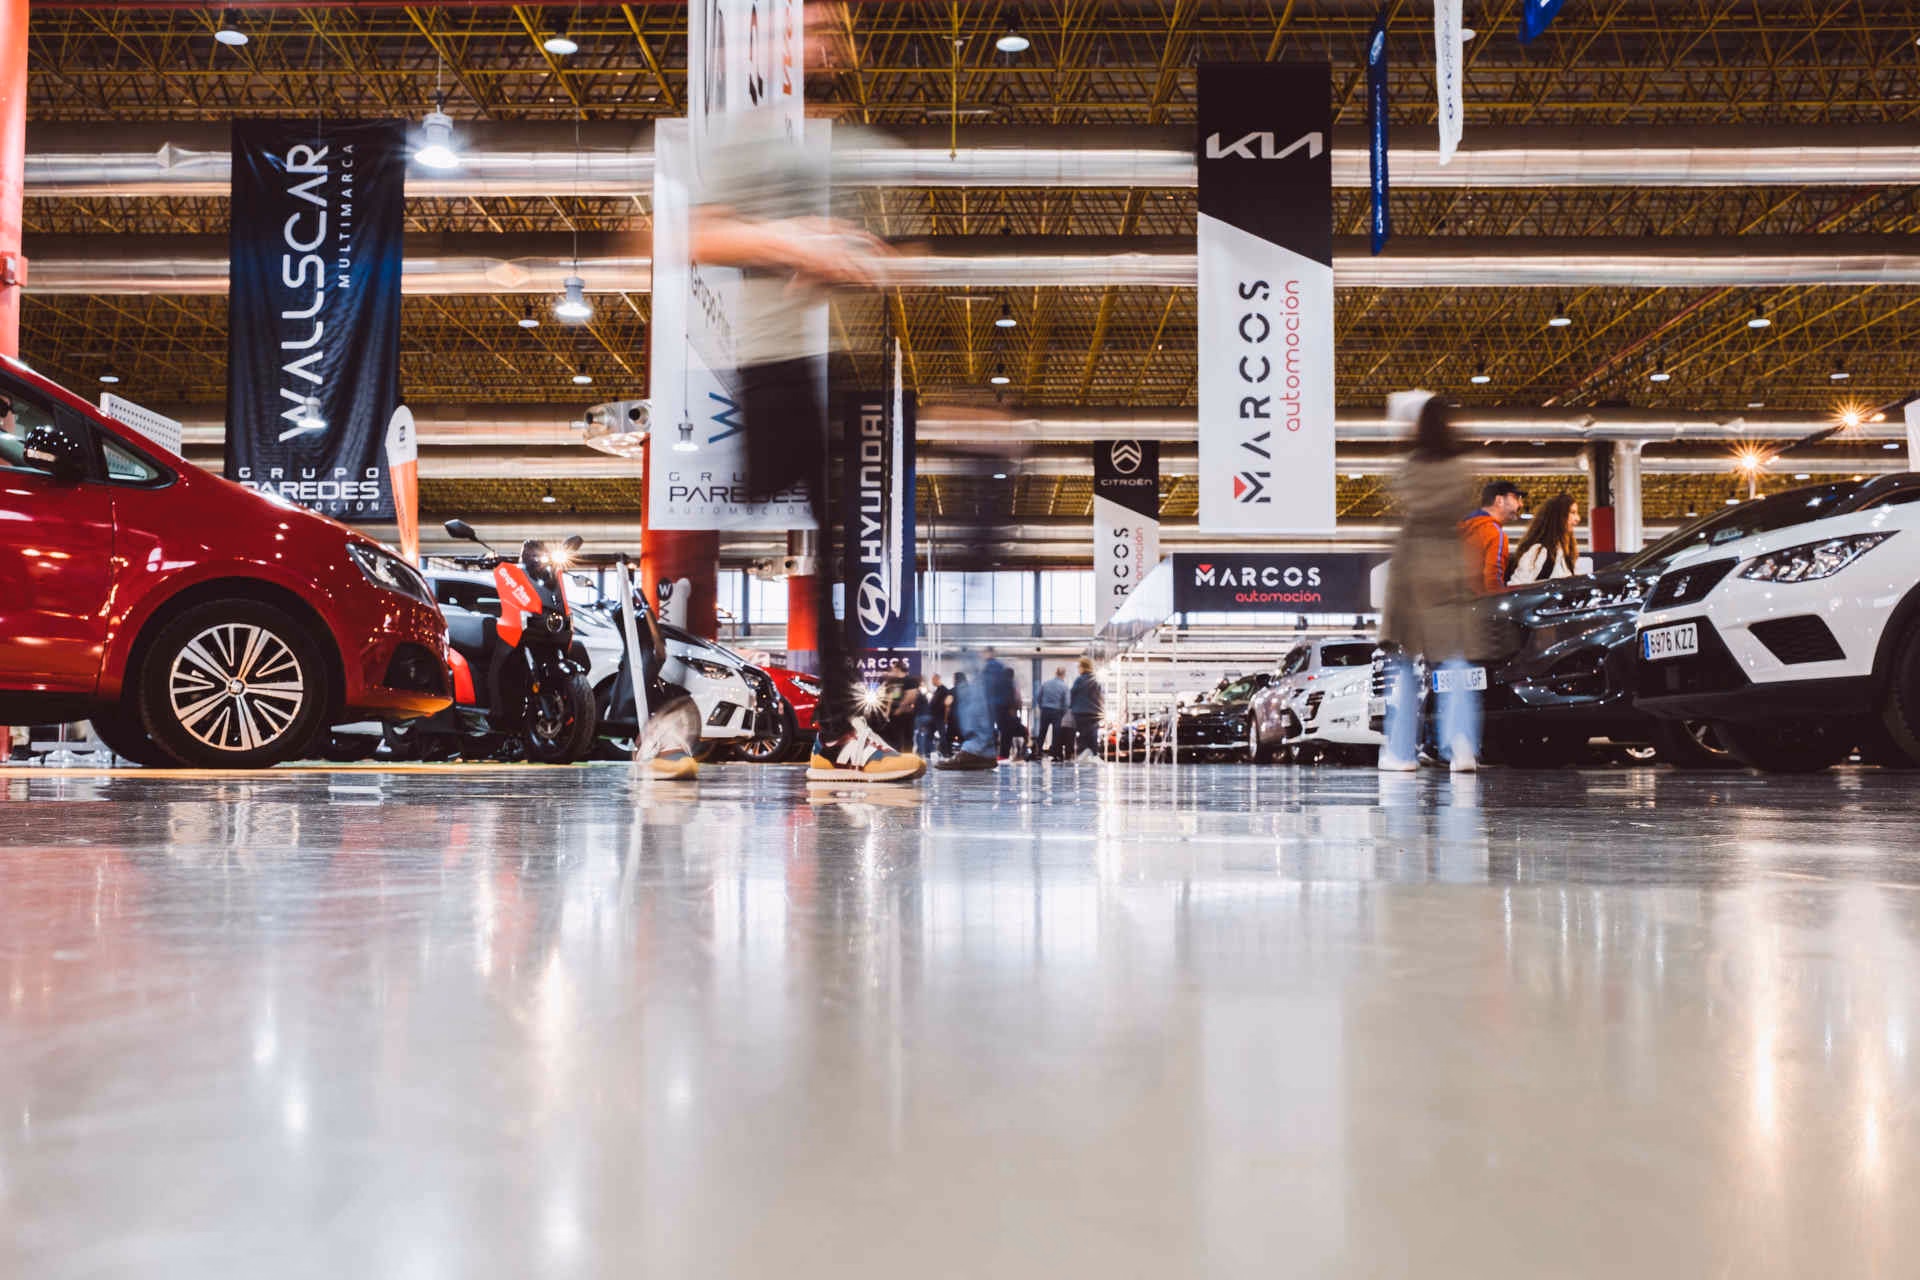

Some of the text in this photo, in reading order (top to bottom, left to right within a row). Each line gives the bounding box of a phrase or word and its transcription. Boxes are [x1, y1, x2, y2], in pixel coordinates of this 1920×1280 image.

[1206, 131, 1323, 160] KIA
[337, 144, 354, 288] MULTIMARCA
[279, 144, 329, 442] WALLSCAR
[1280, 279, 1300, 432] automoción
[1238, 279, 1272, 503] MARCOS
[238, 467, 380, 479] GRUPO
[668, 471, 745, 484] GRU
[860, 404, 883, 564] HYUNDAI
[669, 486, 810, 504] PAREES
[1113, 527, 1129, 610] RCOS
[1195, 565, 1321, 587] MARCOS
[1235, 589, 1321, 603] automoción
[1674, 627, 1695, 650] KZZ
